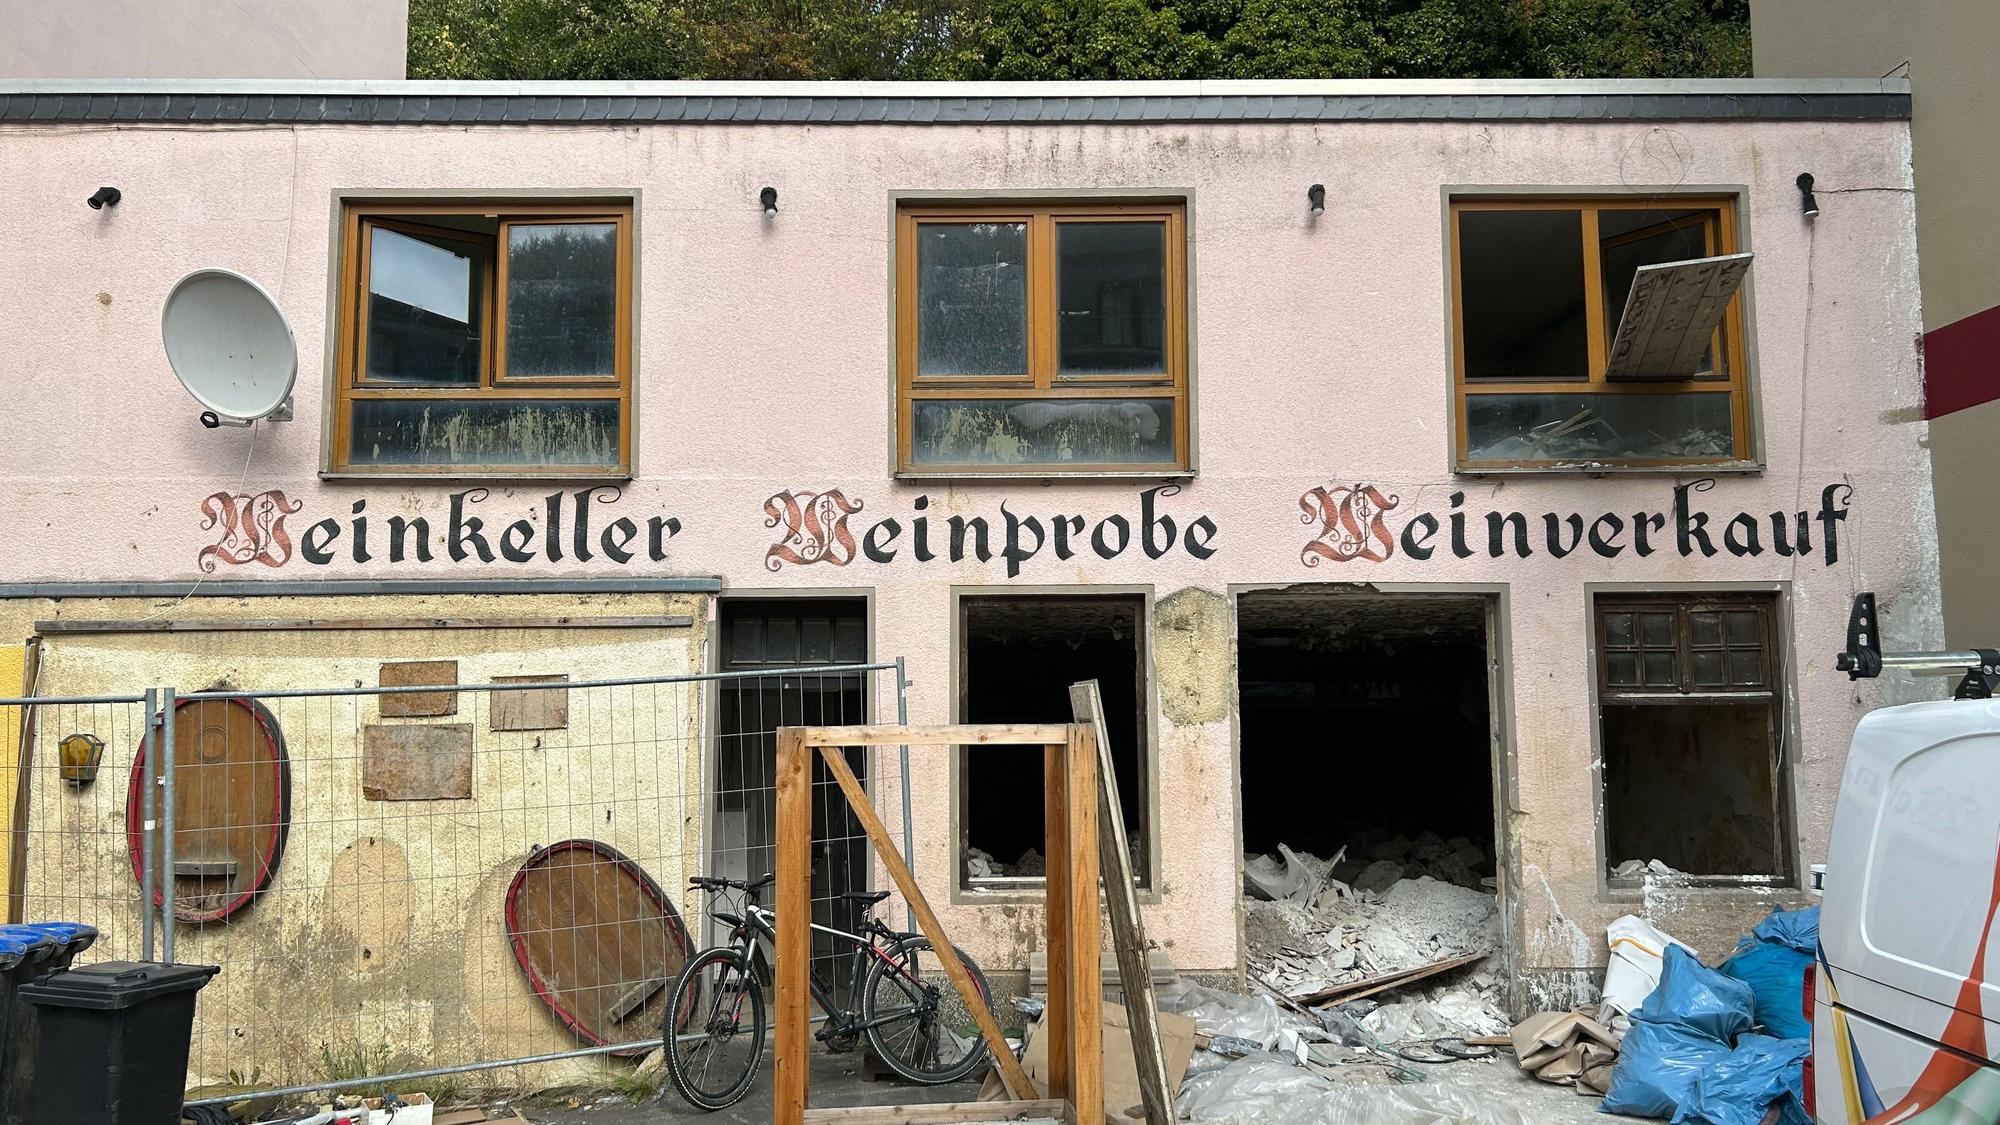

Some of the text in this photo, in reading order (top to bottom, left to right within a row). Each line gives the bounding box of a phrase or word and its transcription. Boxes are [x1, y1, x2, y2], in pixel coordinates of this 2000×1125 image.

[198, 478, 1853, 577] Weinkeller Weinprobe Weinverkauf
